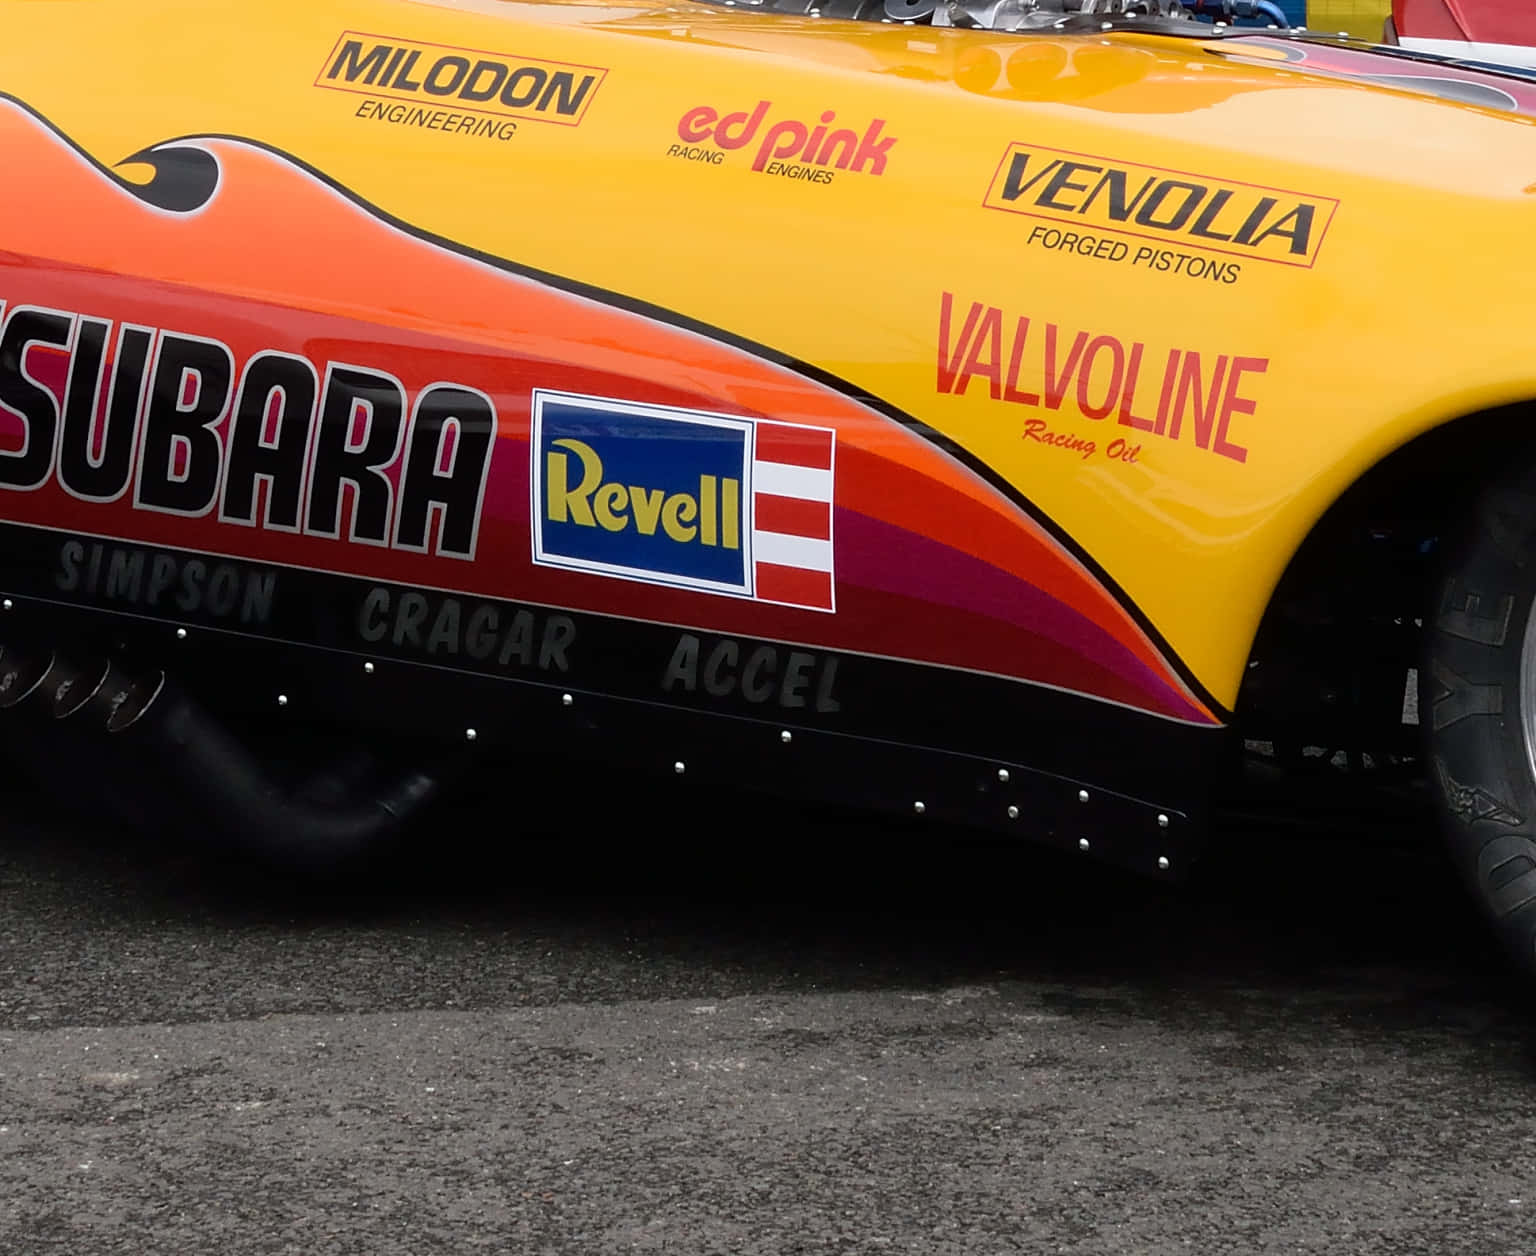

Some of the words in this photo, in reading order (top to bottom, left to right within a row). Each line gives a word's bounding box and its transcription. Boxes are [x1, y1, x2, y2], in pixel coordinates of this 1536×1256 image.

[327, 40, 596, 116] MILODON
[355, 100, 518, 141] ENGINEERING
[677, 100, 771, 151] ed
[752, 110, 898, 177] pink
[667, 144, 725, 165] RACING
[765, 162, 835, 185] ENGINES
[1001, 152, 1316, 255] VENOLIA
[1027, 226, 1128, 262] FORGED
[1133, 246, 1241, 285] PISTONS
[936, 291, 1270, 464] VALVOLINE
[1022, 419, 1098, 460] Racing
[1106, 438, 1142, 464] Oil
[547, 438, 739, 549] Revell
[58, 539, 277, 624] SIMPSON
[358, 587, 576, 671] CRAGAR
[662, 634, 841, 713] ACCEL
